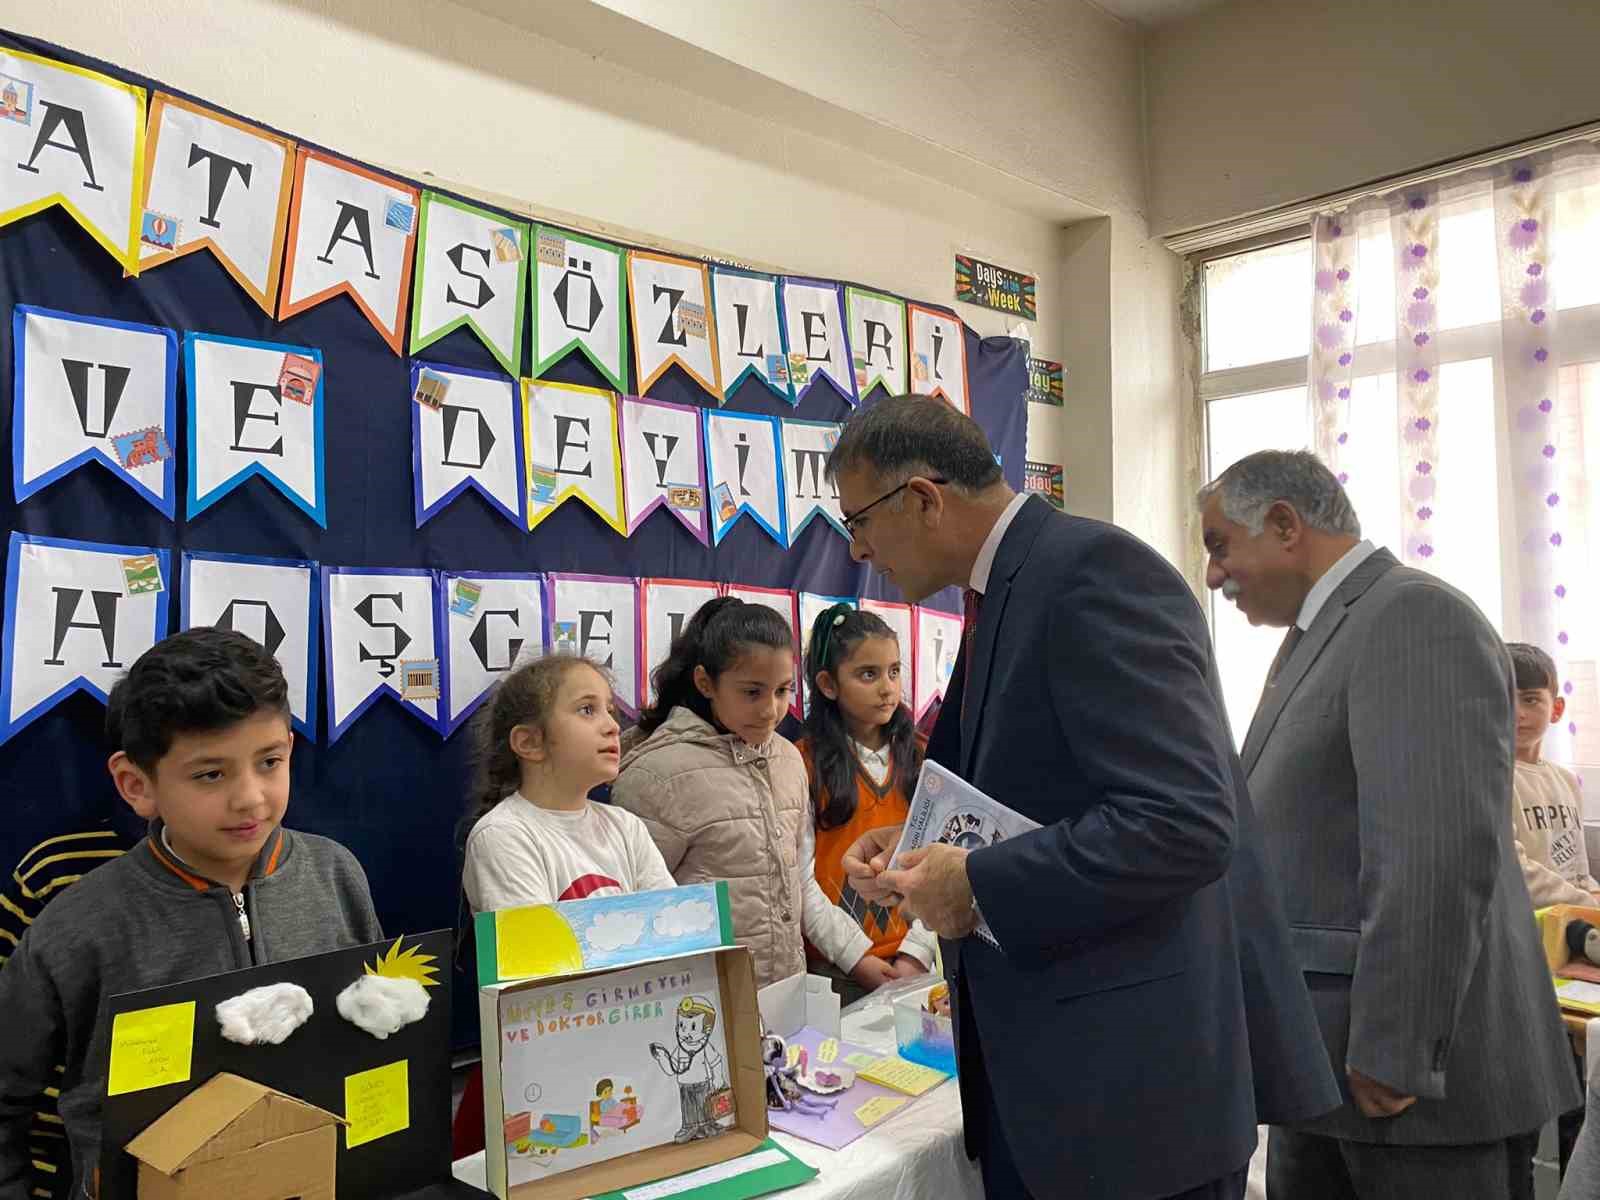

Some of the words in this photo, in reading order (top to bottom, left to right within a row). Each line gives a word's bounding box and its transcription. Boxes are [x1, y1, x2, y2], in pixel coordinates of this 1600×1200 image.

[976, 263, 1003, 288] Days
[988, 288, 1021, 312] Week
[61, 358, 284, 457] VE
